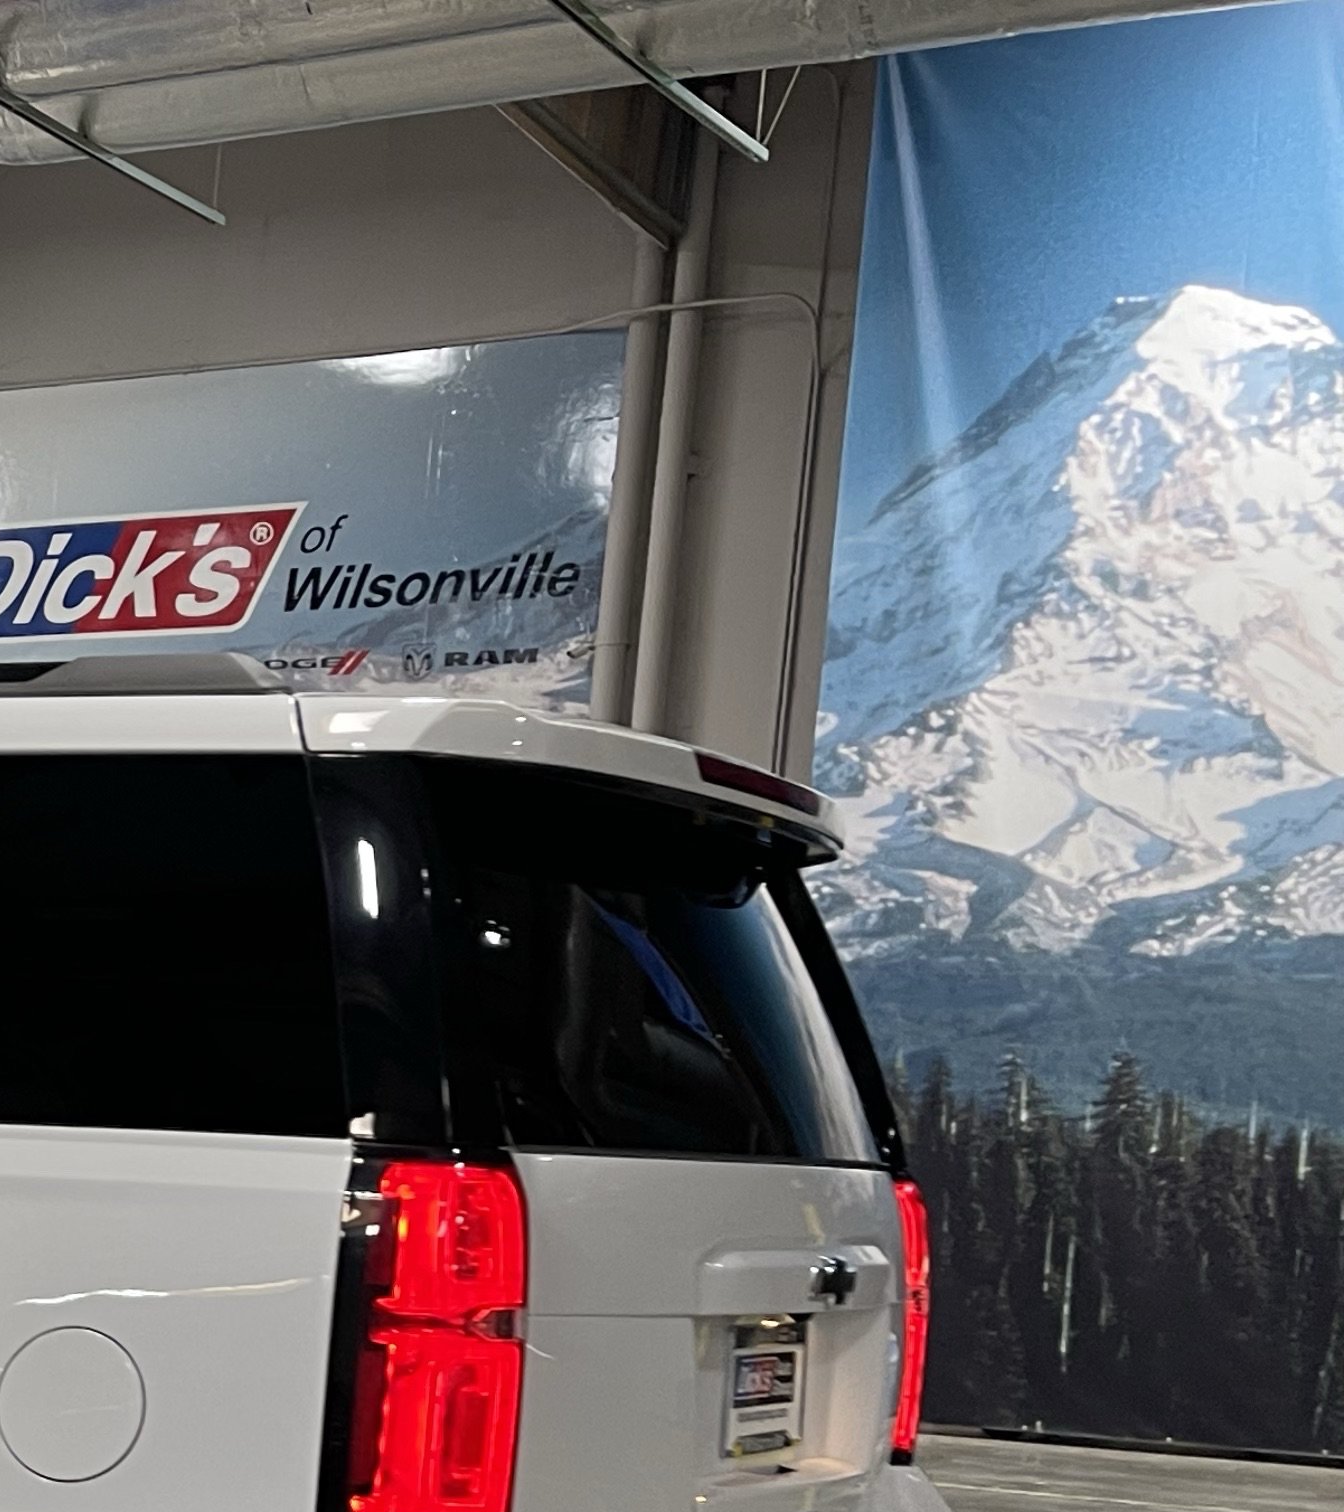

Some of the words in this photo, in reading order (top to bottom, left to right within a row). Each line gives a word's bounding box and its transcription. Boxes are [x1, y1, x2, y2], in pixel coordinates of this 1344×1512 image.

[300, 514, 349, 553] of
[284, 550, 580, 612] Wilsonville
[444, 648, 539, 667] RAM
